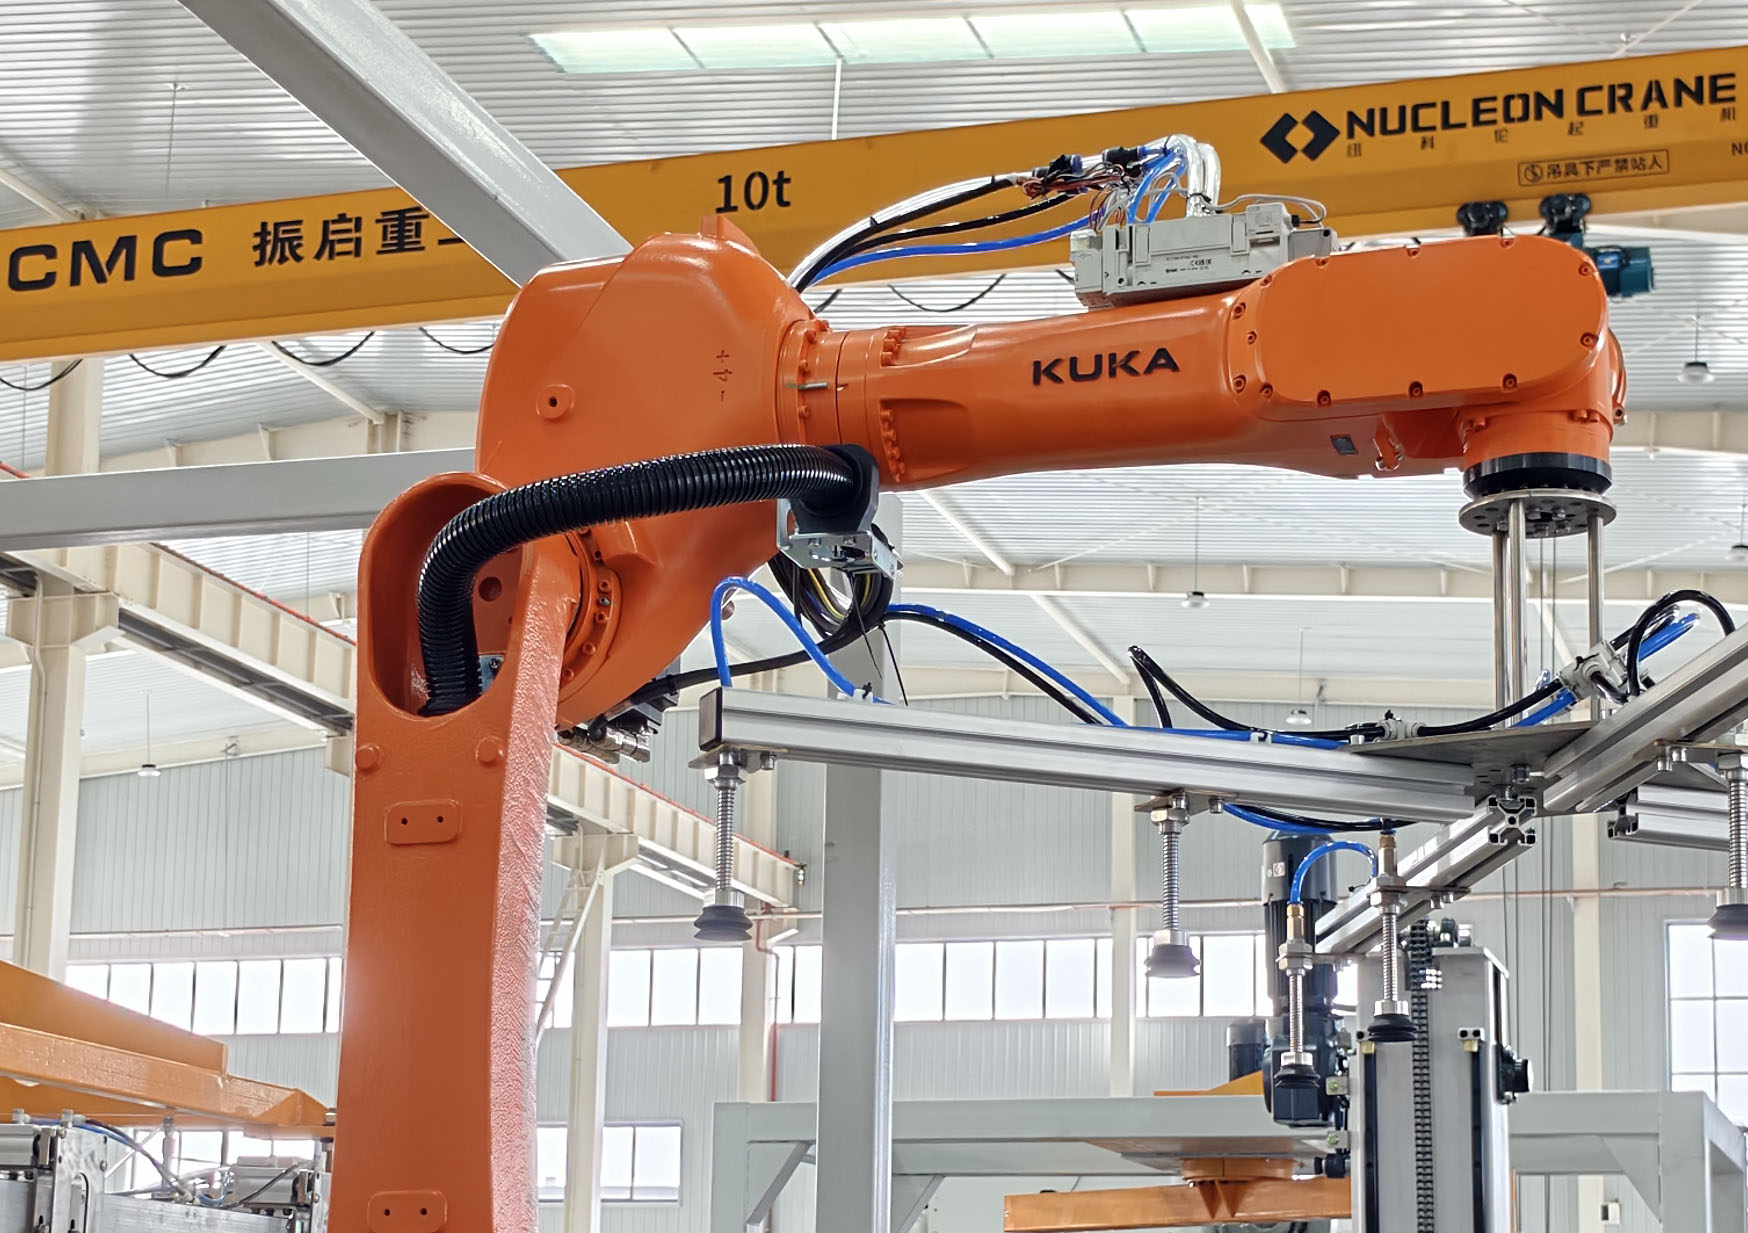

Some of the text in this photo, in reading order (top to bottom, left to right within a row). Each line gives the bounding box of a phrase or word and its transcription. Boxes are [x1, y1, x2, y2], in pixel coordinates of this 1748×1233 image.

[1346, 72, 1737, 140] NUCLEON CRANE
[715, 170, 792, 214] 10t
[8, 227, 204, 293] CMC
[1032, 346, 1180, 386] KUKA
